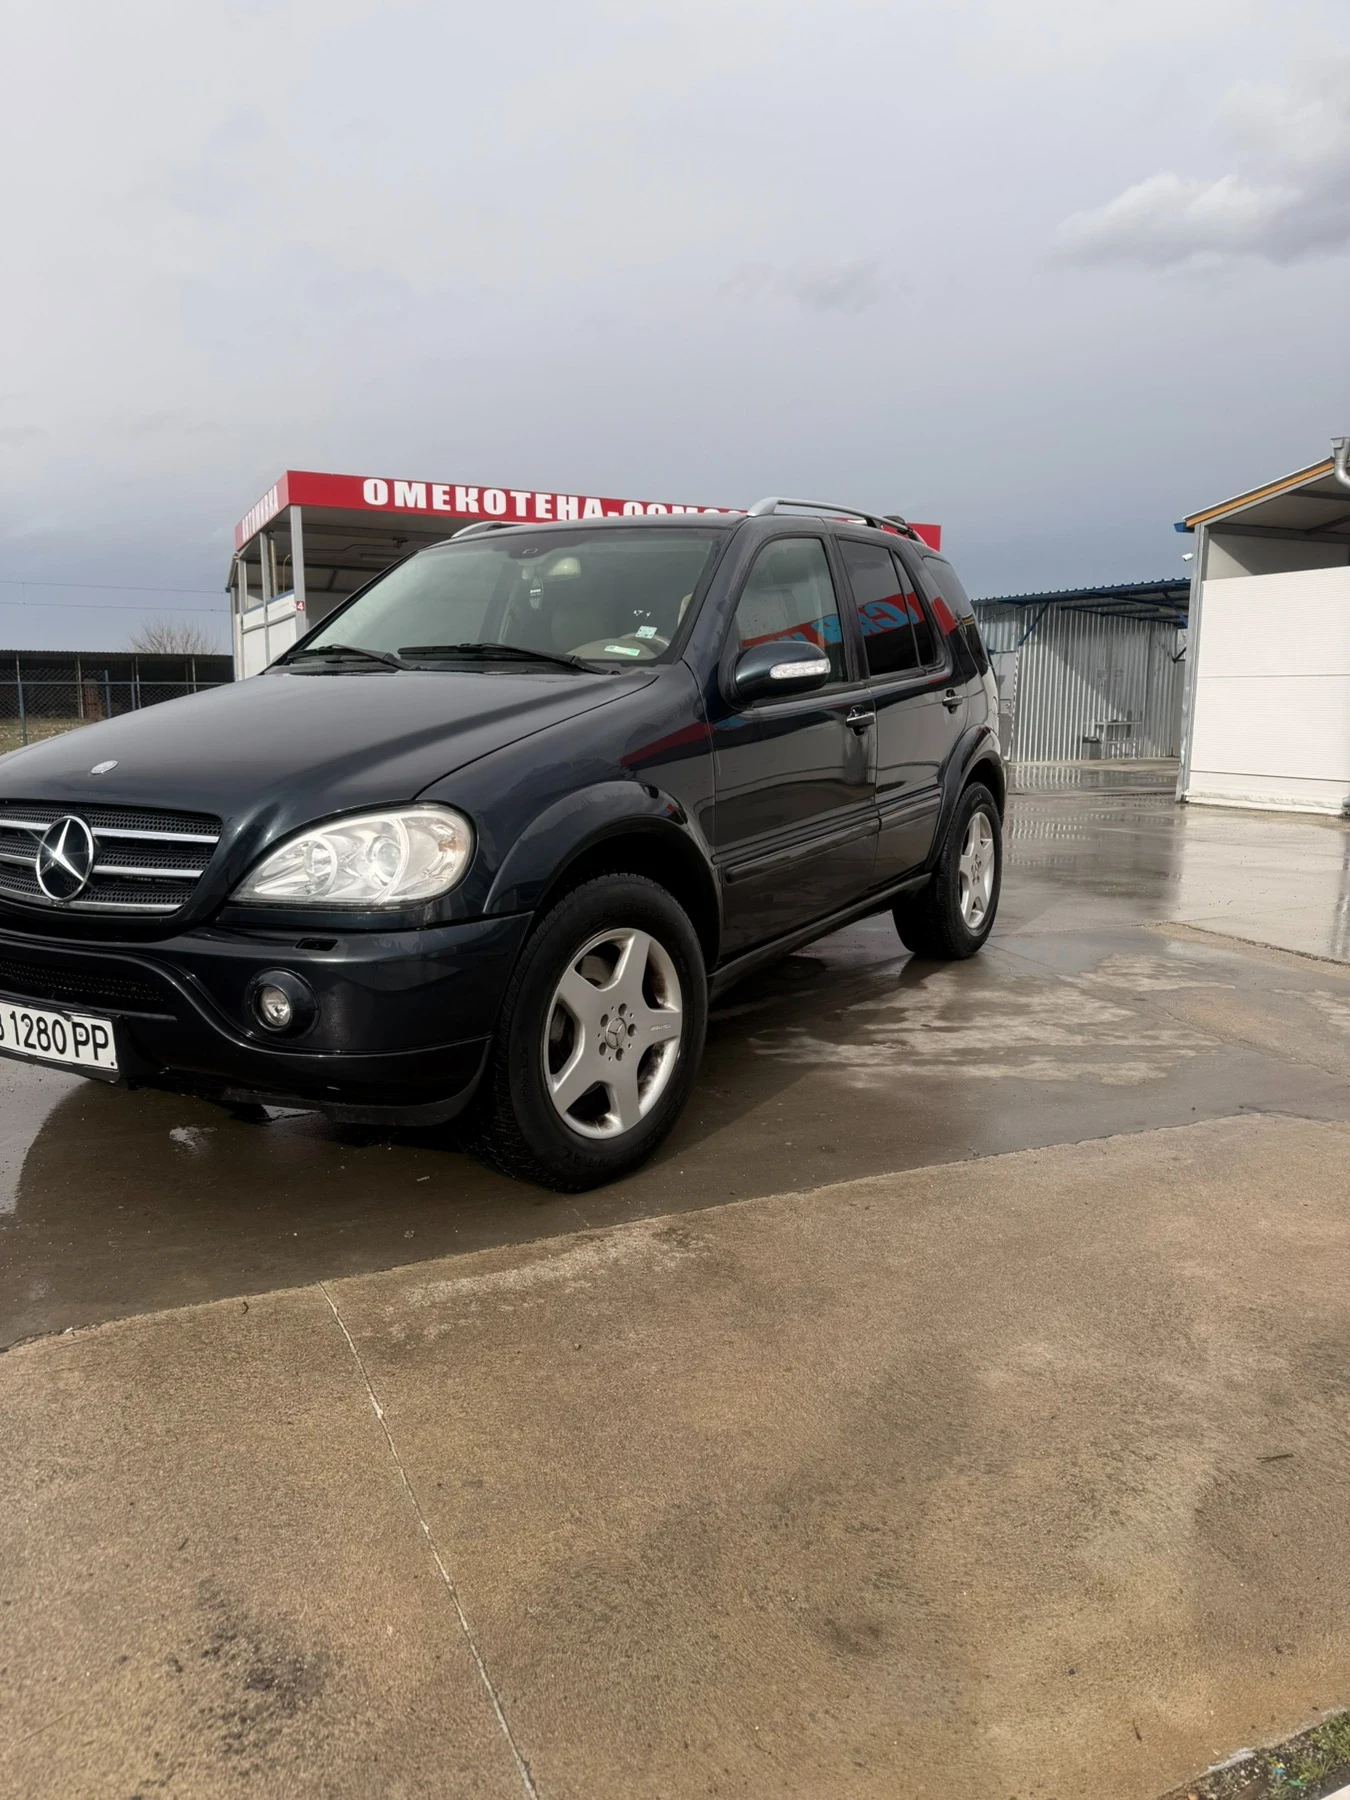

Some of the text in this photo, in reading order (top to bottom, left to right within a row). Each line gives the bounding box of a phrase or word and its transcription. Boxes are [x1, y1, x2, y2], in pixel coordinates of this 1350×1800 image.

[297, 601, 304, 611] 4
[10, 1010, 67, 1055] 1280
[72, 1021, 109, 1061] PP
